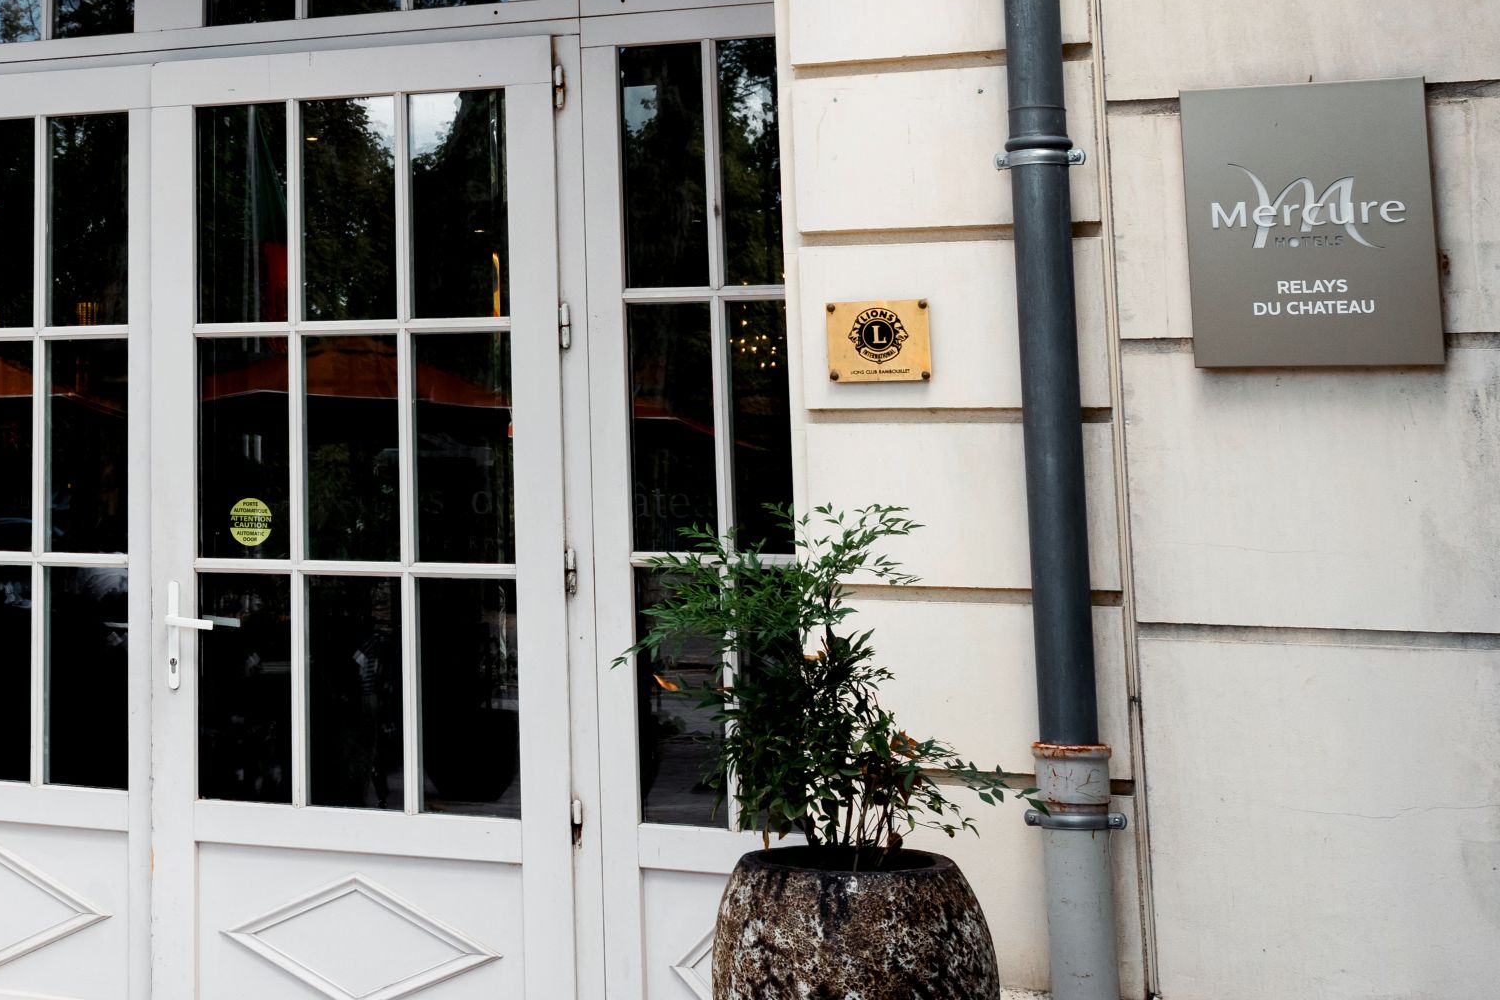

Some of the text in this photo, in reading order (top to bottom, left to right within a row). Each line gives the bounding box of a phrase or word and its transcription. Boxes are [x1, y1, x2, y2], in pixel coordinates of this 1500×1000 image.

[1211, 200, 1407, 229] Mercure
[1274, 235, 1345, 248] HOTELS
[1276, 279, 1349, 295] RELAYS
[1253, 299, 1376, 316] DU CHATEAU
[860, 310, 894, 322] LIONS
[871, 325, 888, 344] L
